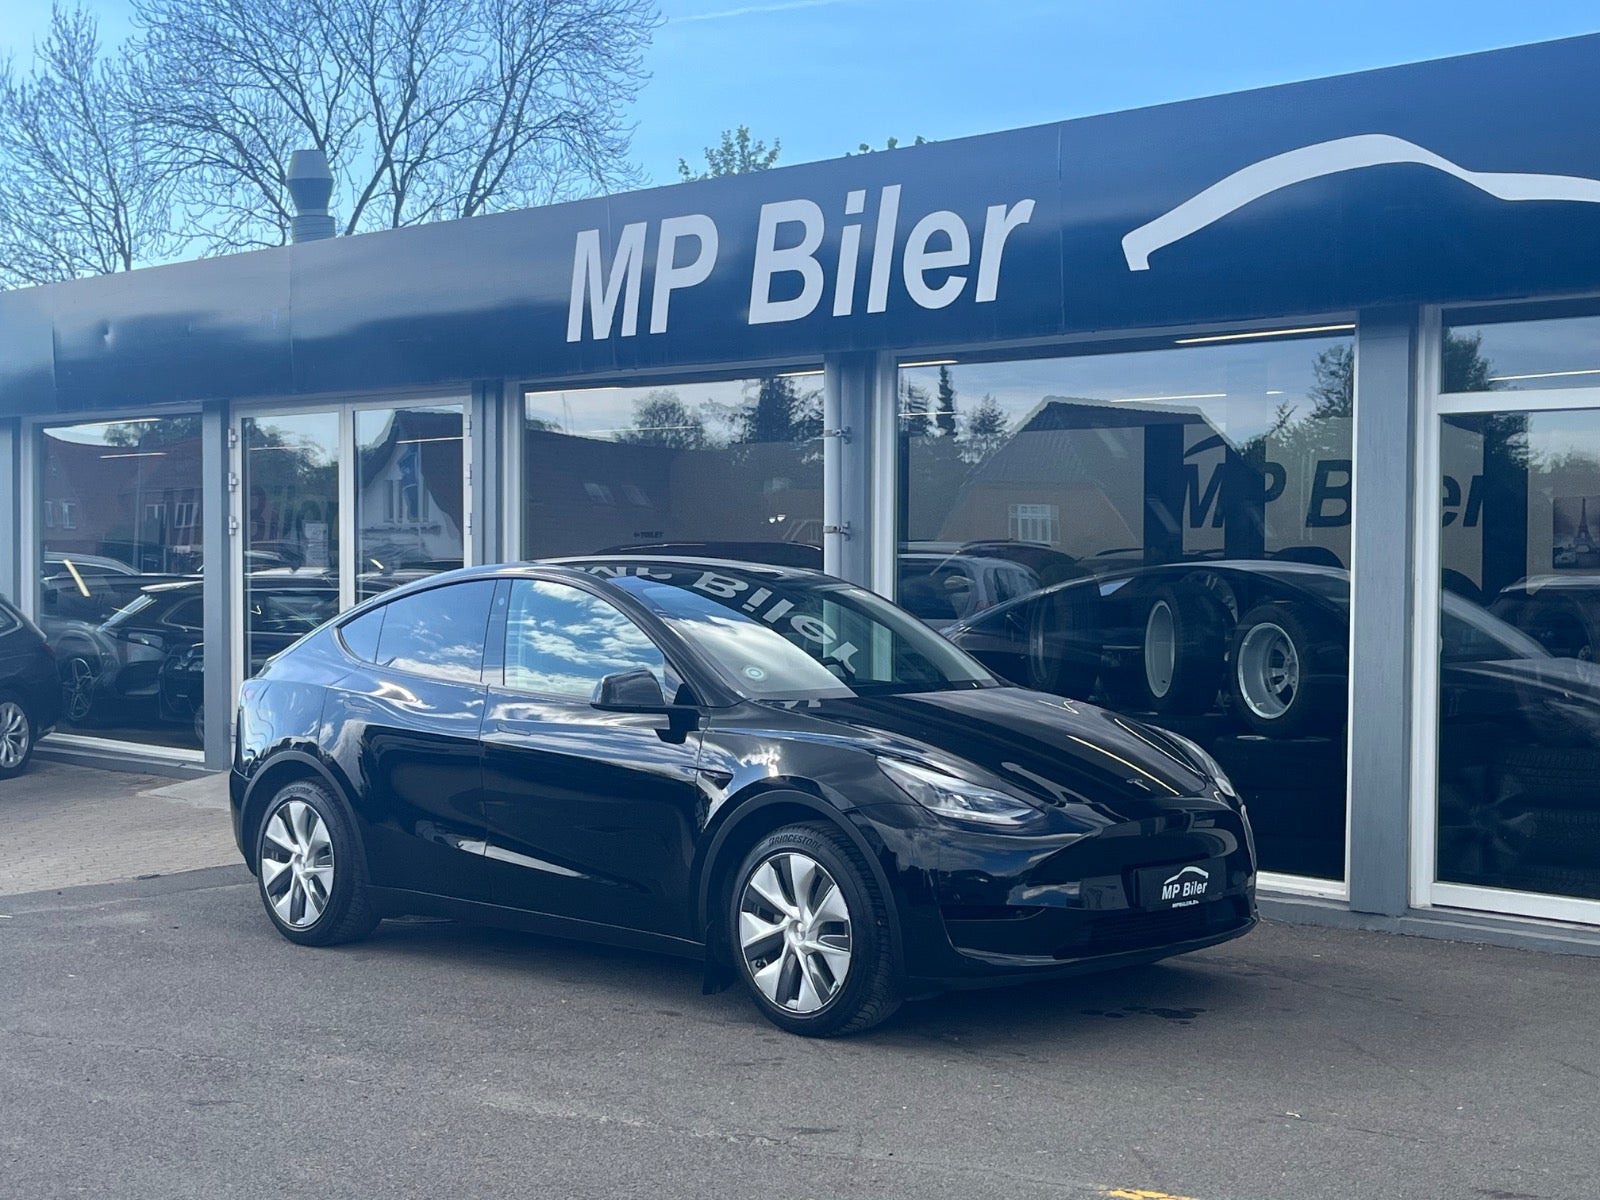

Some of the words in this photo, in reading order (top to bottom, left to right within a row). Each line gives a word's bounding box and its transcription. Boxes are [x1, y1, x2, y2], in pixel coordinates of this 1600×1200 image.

[566, 214, 719, 342] MP
[748, 184, 1036, 325] Biler
[768, 833, 823, 850] BRIDGESTONE
[1162, 884, 1180, 900] MP
[1183, 881, 1207, 896] Biler
